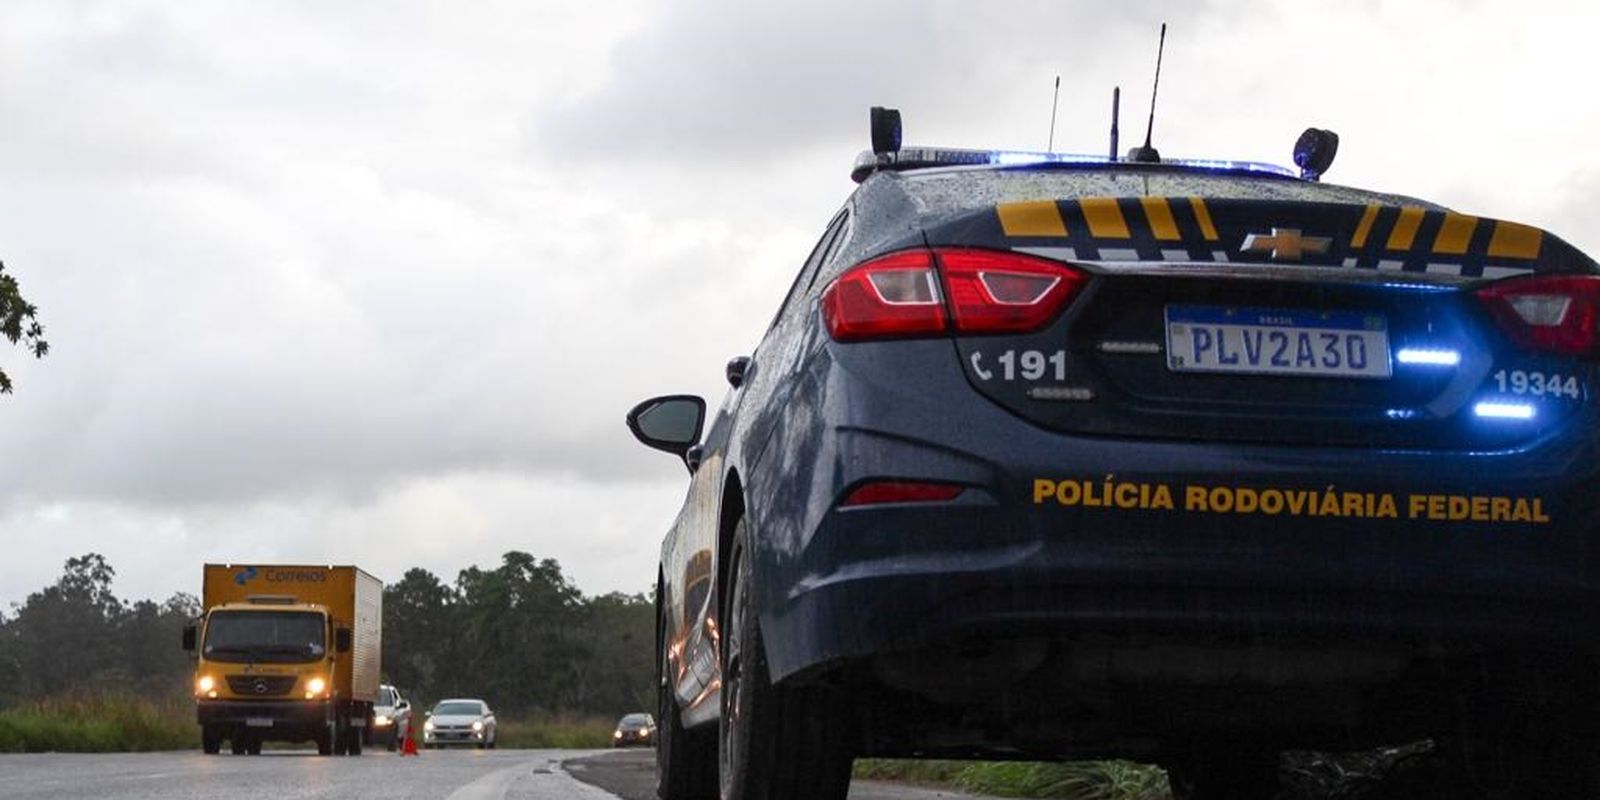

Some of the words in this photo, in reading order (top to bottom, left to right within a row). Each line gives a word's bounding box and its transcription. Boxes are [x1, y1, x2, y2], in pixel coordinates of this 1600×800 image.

[1259, 315, 1293, 325] BRASIL
[1191, 326, 1367, 370] PLV2A30
[998, 350, 1065, 380] 191
[1494, 369, 1579, 399] 19344
[1033, 474, 1174, 510] POLÍCIA
[1185, 484, 1398, 518] RODOVIÁRIA
[1408, 494, 1550, 522] FEDERAL
[265, 568, 327, 582] Correios
